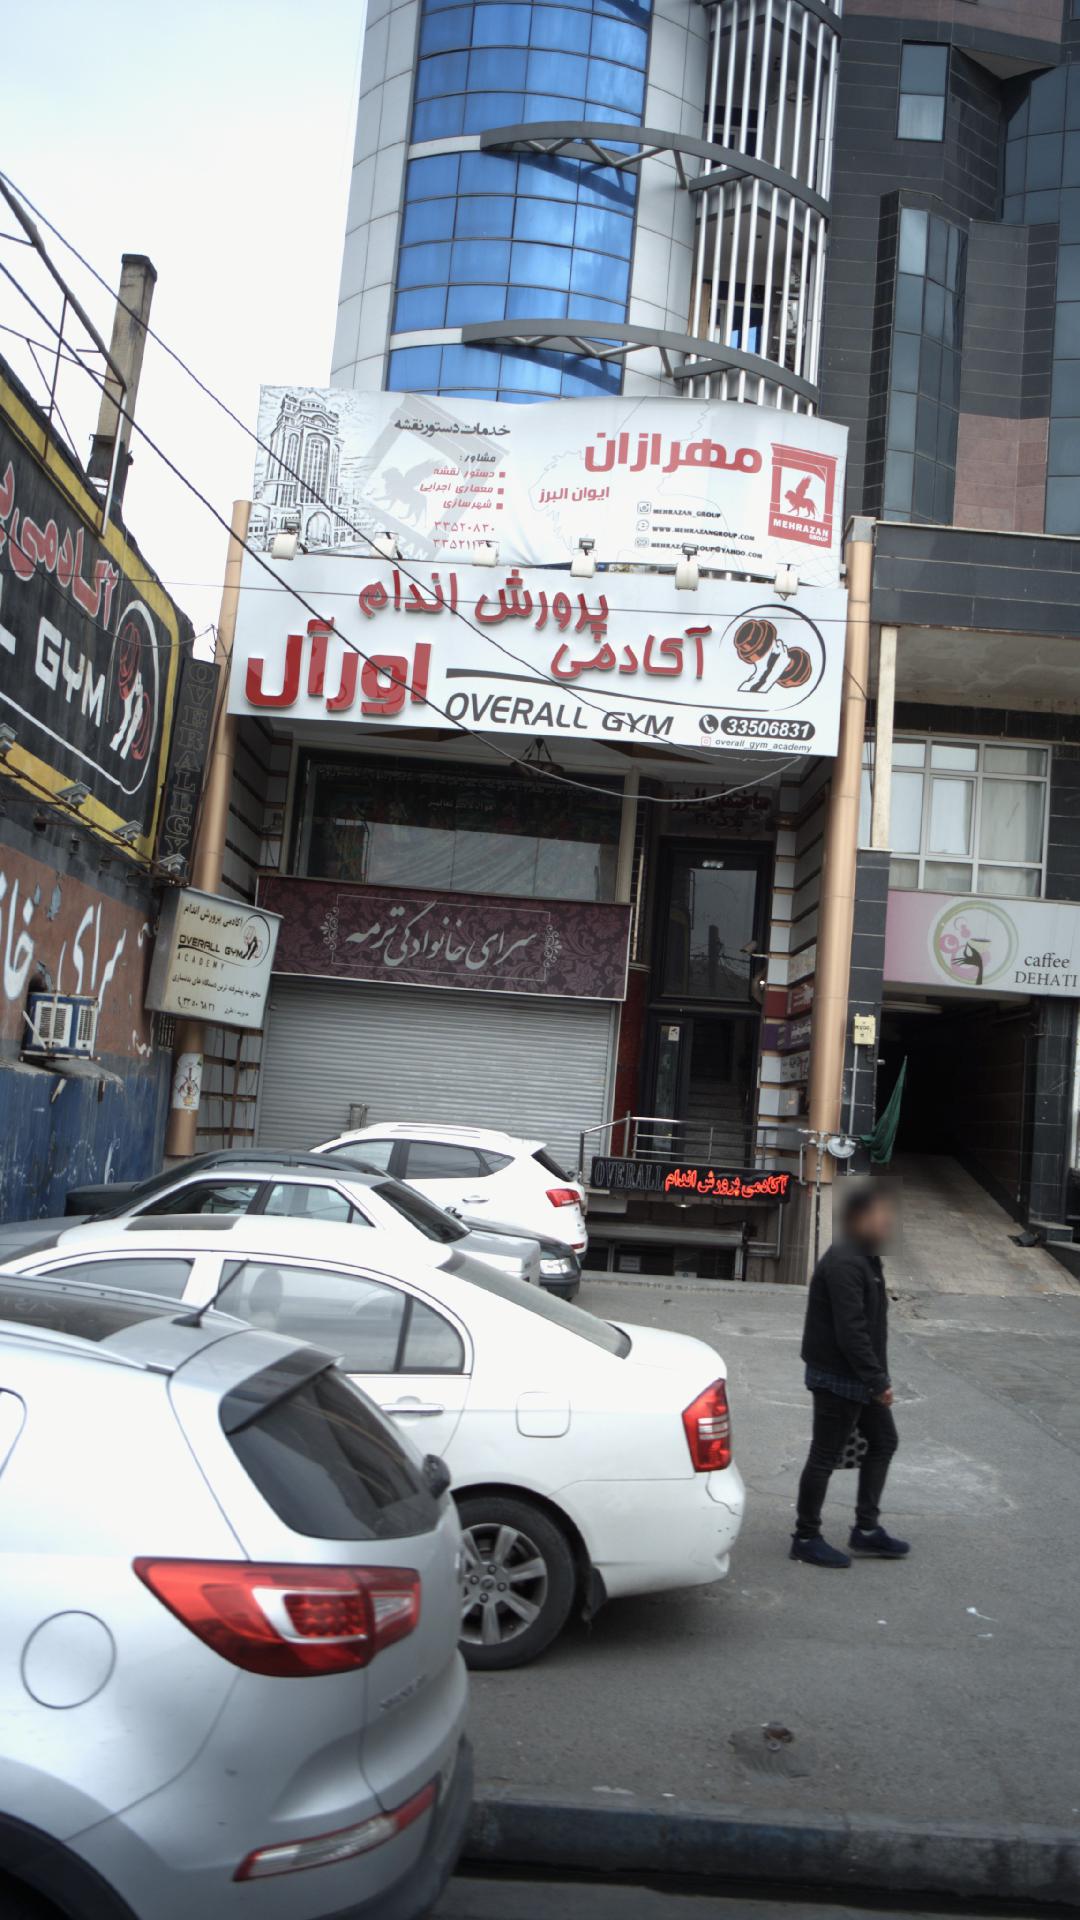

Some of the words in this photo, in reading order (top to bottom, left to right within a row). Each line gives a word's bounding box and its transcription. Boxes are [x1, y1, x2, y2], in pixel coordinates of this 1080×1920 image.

[460, 422, 511, 436] خدمات
[585, 432, 763, 473] مهرازان
[455, 484, 494, 494] معماری
[537, 487, 569, 504] البرز
[571, 486, 611, 502] ایوان
[773, 518, 829, 537] MEHRAZAN
[808, 533, 829, 543] GROUP
[8, 507, 119, 631] آکادمی
[358, 569, 458, 618] اندام
[474, 568, 610, 642] پرورش
[549, 624, 713, 681] آکادمی
[35, 616, 106, 728] GYM
[245, 616, 433, 716] اورآل
[445, 691, 589, 730] OVERALL
[602, 711, 675, 736] GYM
[726, 718, 812, 739] 33506831
[715, 738, 812, 754] overall_gym_academy
[345, 906, 405, 949] ترمه
[382, 899, 466, 967] خانوادگی
[179, 934, 220, 953] OVERALL
[224, 946, 243, 958] GYM
[465, 930, 538, 971] سرای
[177, 952, 225, 971] ACADEMY
[1024, 952, 1071, 969] caffee
[1014, 970, 1079, 988] DEHATI
[594, 1161, 664, 1192] OVERALL
[665, 1168, 698, 1192] اندام
[697, 1170, 742, 1197] پرورش
[741, 1174, 790, 1198] آکادمی
